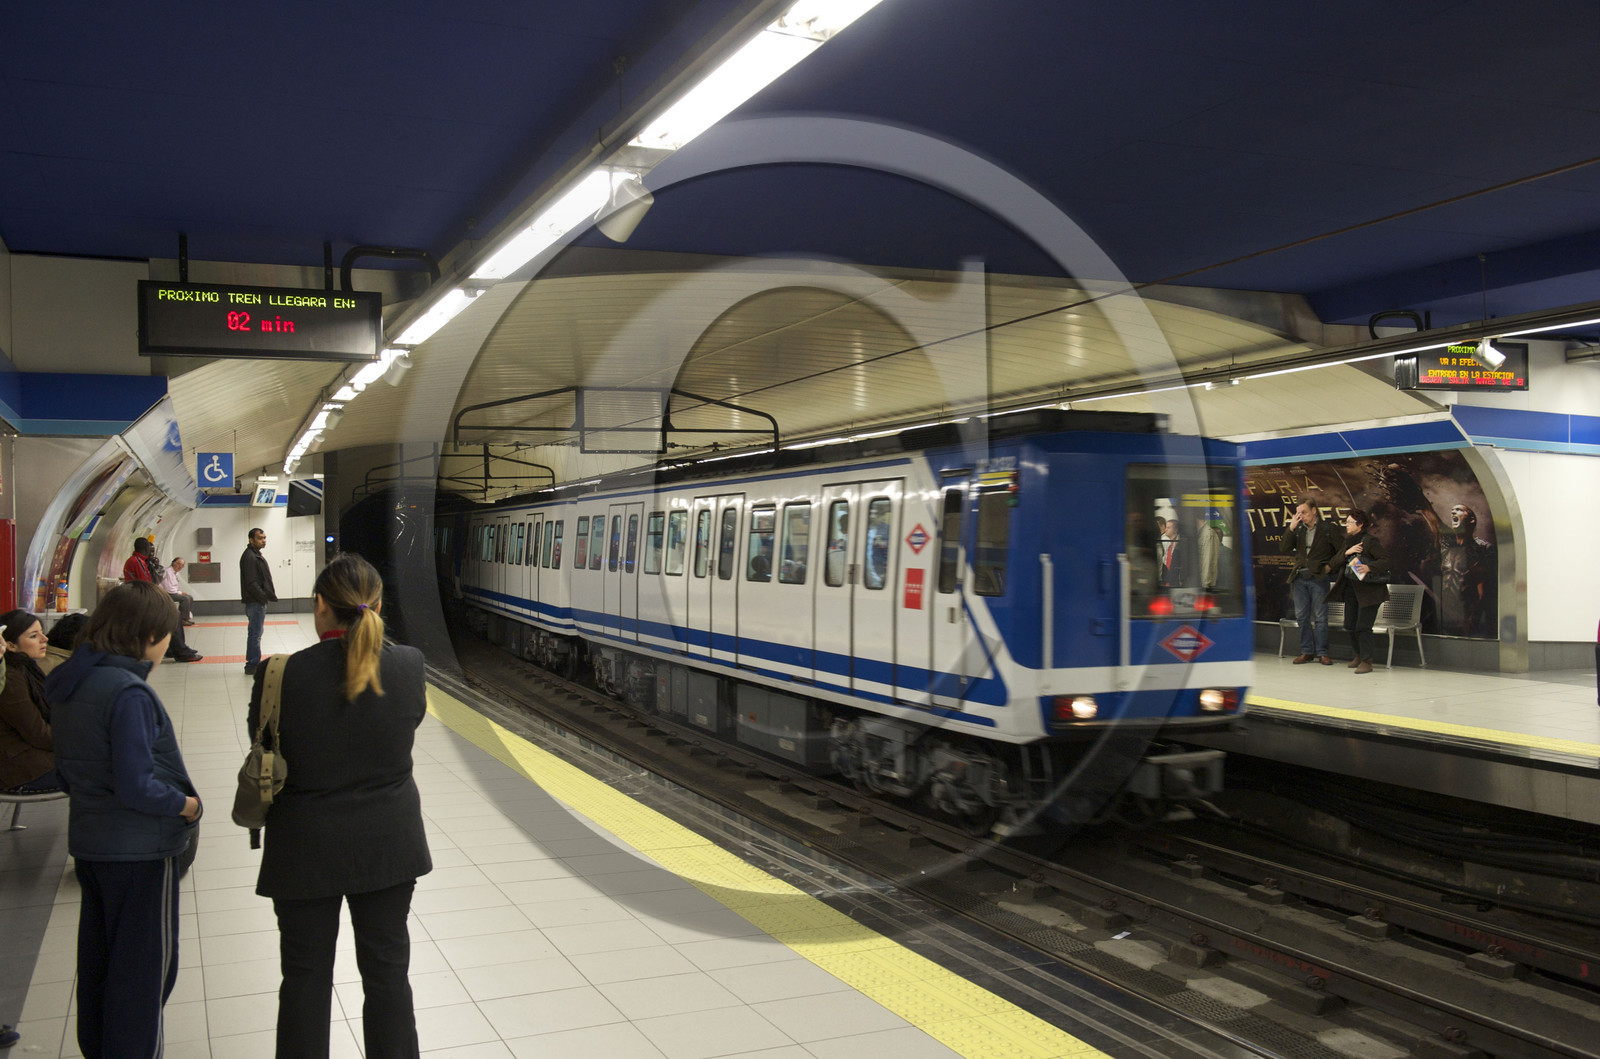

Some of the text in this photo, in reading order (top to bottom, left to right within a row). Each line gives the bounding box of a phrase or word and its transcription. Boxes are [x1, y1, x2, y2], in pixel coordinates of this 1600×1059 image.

[158, 289, 356, 309] PROXIMO TREN LLEGARA EN:
[226, 310, 295, 333] 02 min
[1447, 345, 1476, 354] PROXIMO
[1439, 357, 1450, 366] VA
[1451, 357, 1457, 366] A
[1427, 369, 1515, 380] ENTRADA EN LA ESTACION
[1420, 376, 1443, 384] DEJEN
[1448, 377, 1469, 385] SALIR
[1475, 377, 1496, 386] ANTES
[1502, 378, 1511, 386] DE
[1245, 476, 1324, 496] FURIA
[1281, 495, 1298, 505] DE
[1244, 505, 1352, 533] TITAES
